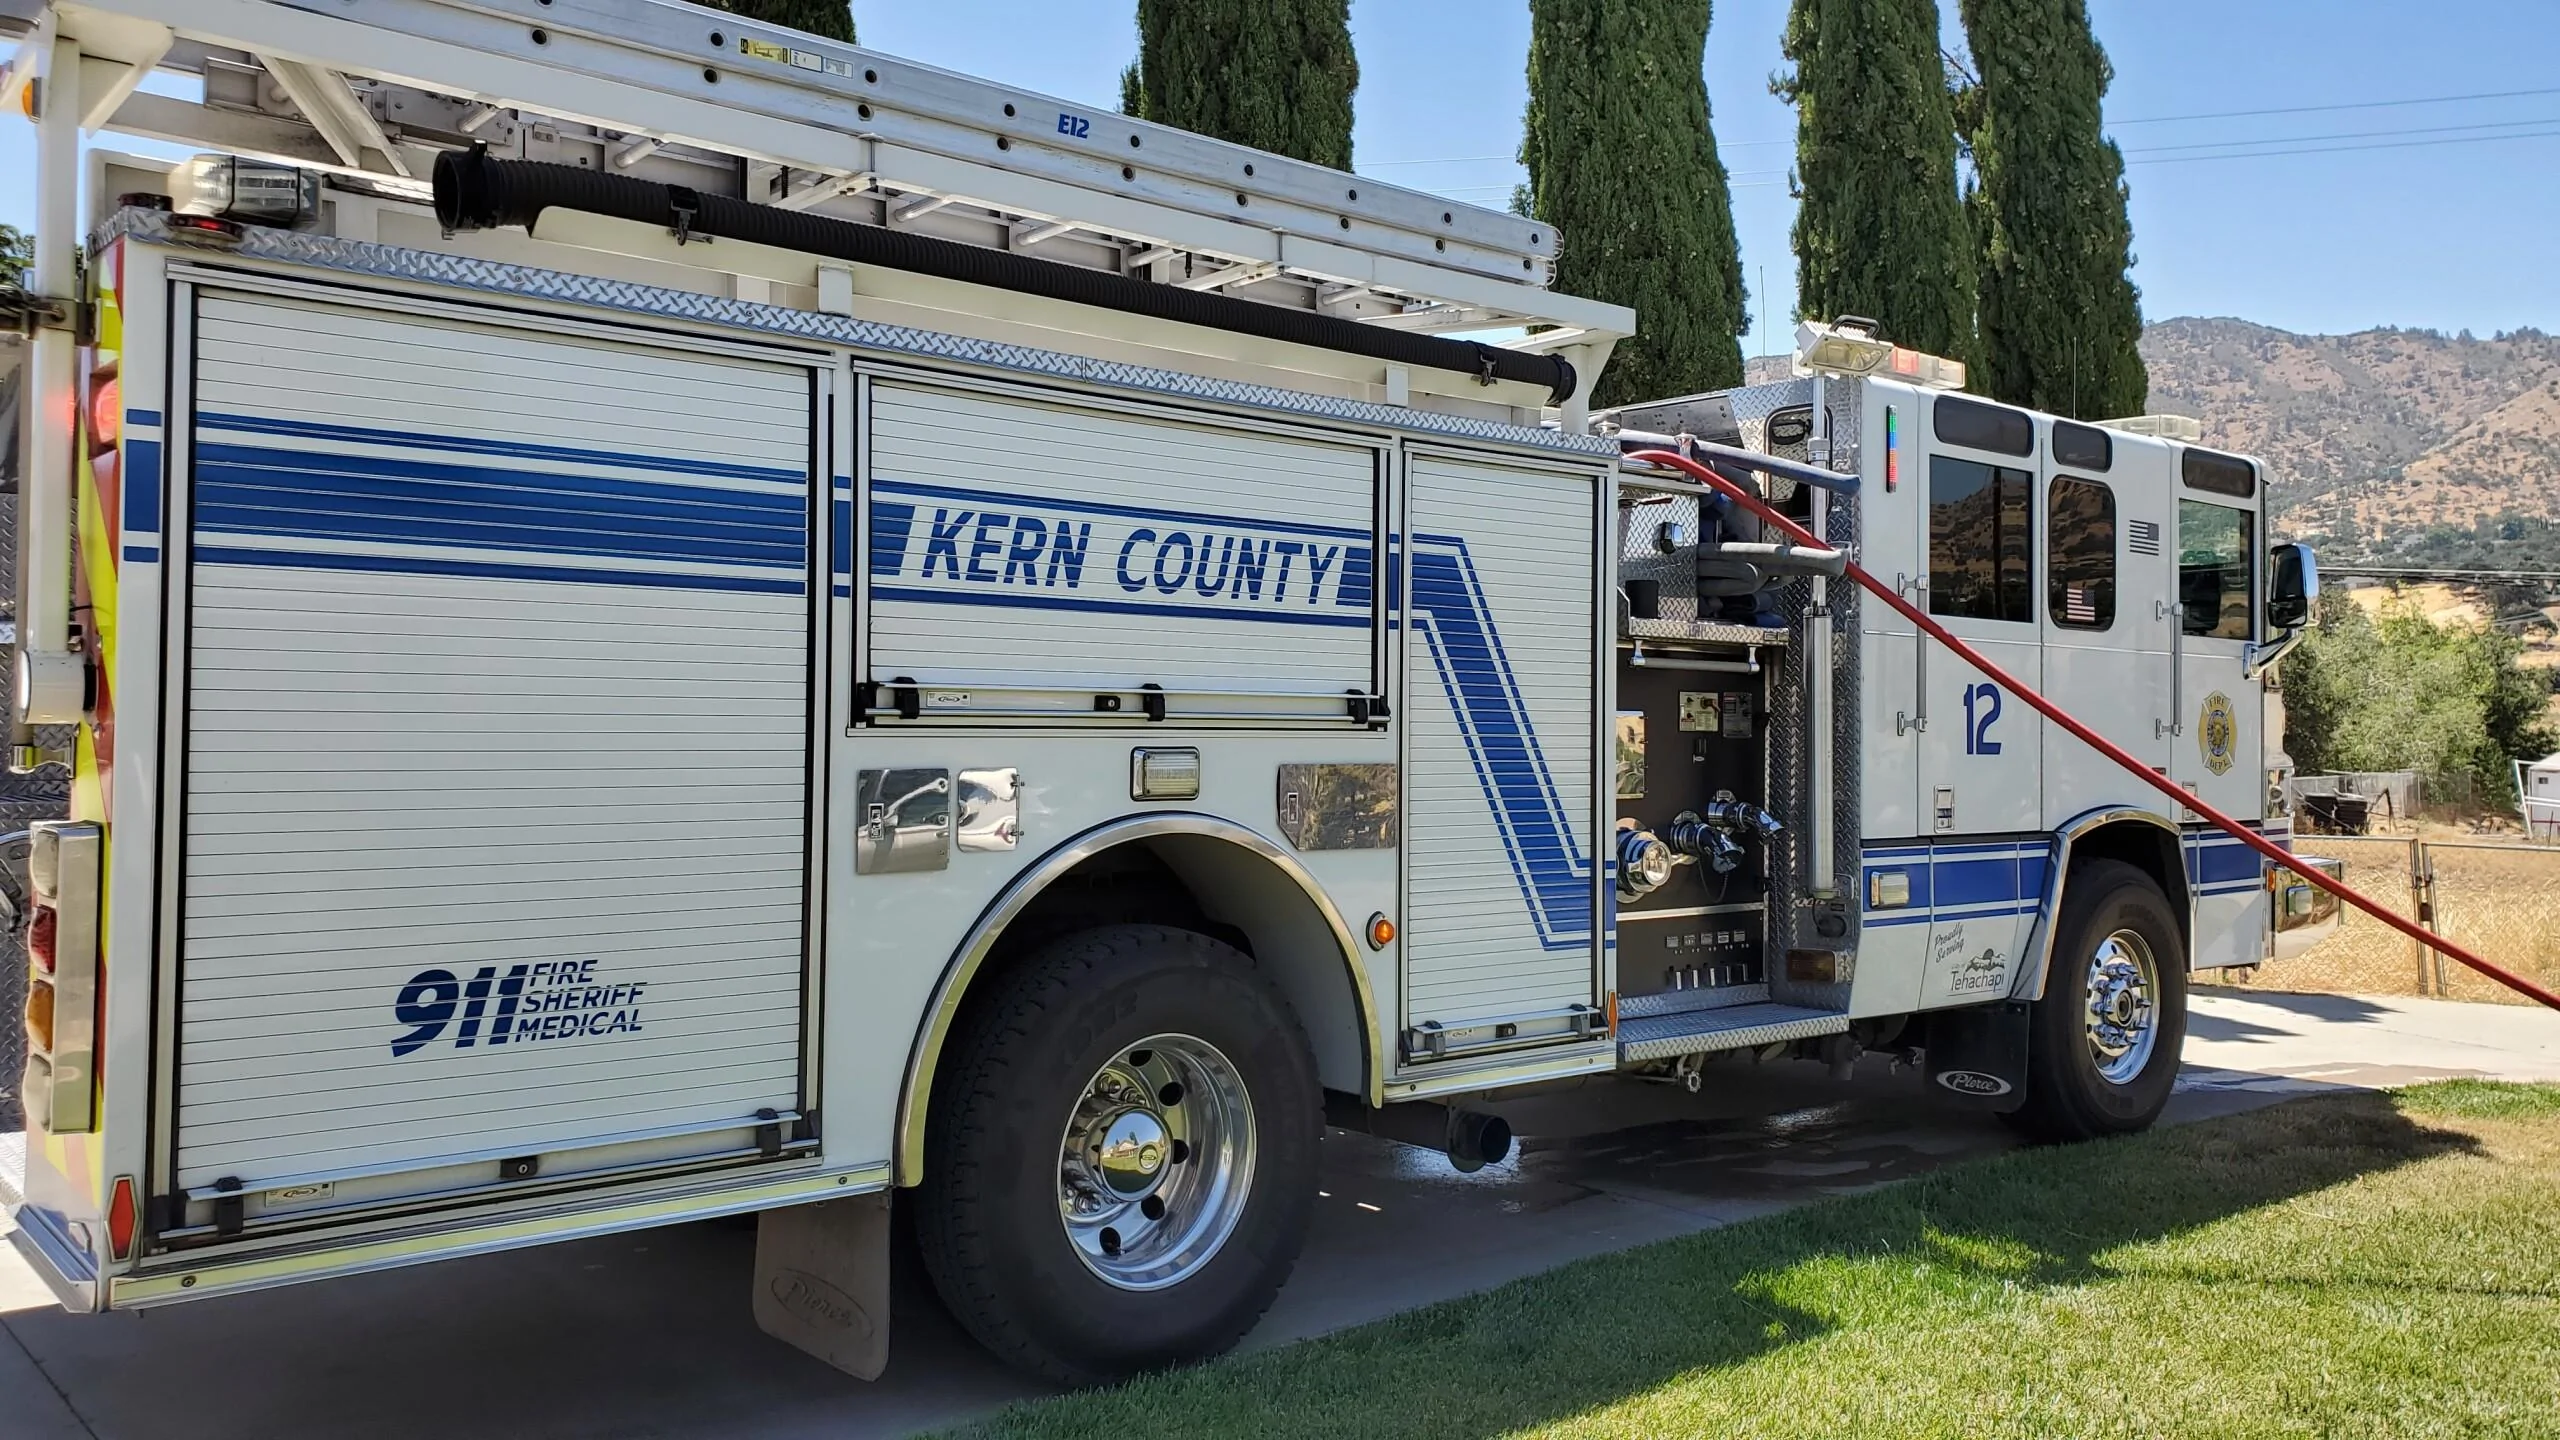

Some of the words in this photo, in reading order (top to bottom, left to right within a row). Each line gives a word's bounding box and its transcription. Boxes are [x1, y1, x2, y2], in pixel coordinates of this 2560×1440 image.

[1058, 113, 1090, 139] E12
[921, 508, 1091, 589] KERN
[1116, 527, 1339, 605] COUNTY
[2209, 695, 2225, 707] FIRE
[1963, 683, 2002, 755] 12
[529, 959, 598, 987] FIRE
[1951, 970, 2005, 993] Tehachapi
[390, 965, 529, 1057] 911
[522, 982, 648, 1013] SHERIFF
[515, 1008, 643, 1043] MEDICAL
